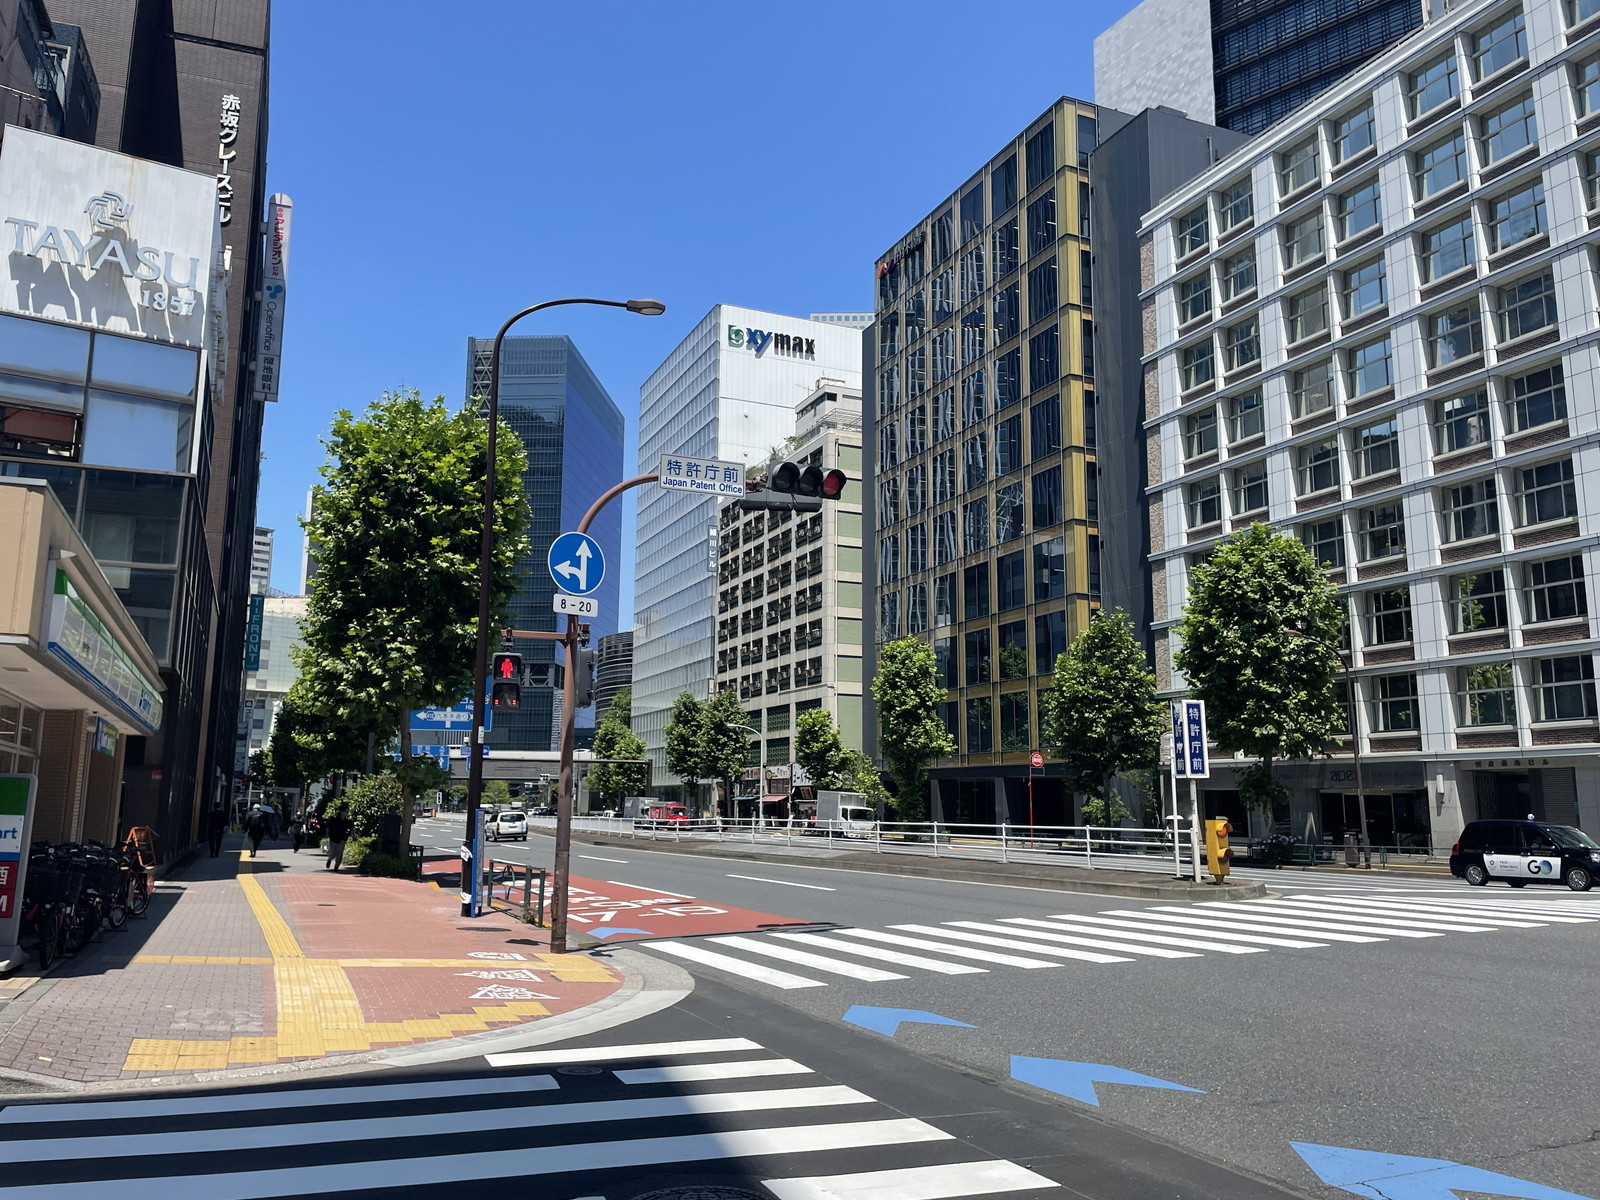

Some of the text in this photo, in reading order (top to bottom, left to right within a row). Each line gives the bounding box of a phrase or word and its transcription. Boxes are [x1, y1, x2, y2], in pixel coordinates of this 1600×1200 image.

[4, 216, 200, 292] TAYASU
[139, 289, 197, 317] 1857
[666, 459, 739, 483] 特許庁前
[662, 476, 743, 494] Japan Patent Office
[1188, 707, 1203, 771] 特許庁前
[1330, 769, 1358, 783] ape
[1527, 859, 1553, 875] GO
